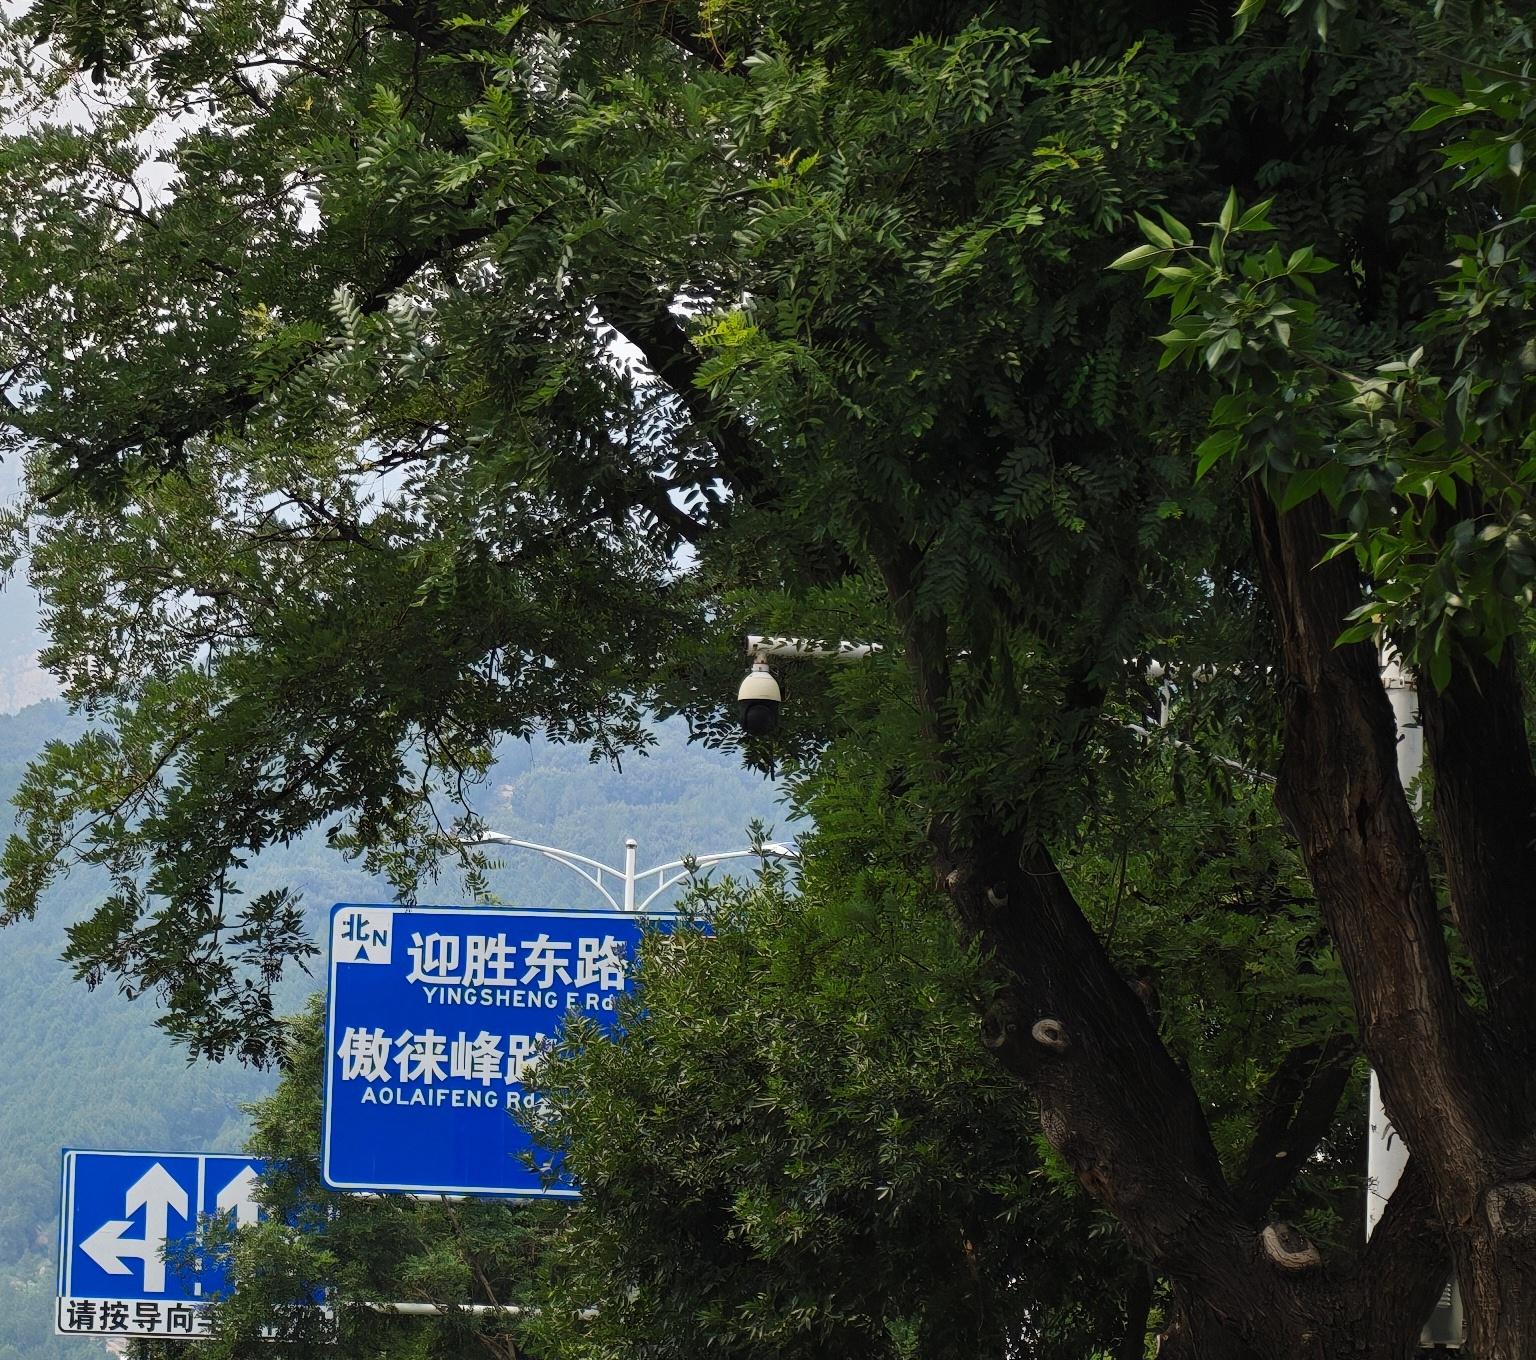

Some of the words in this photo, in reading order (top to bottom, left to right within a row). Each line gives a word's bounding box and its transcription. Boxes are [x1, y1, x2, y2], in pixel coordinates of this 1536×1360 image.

[342, 913, 370, 942] 北
[406, 932, 629, 991] 迎胜东路
[422, 986, 559, 1009] YINGSHENG
[361, 1087, 498, 1108] AOLAIFENG
[506, 1091, 537, 1110] Rd
